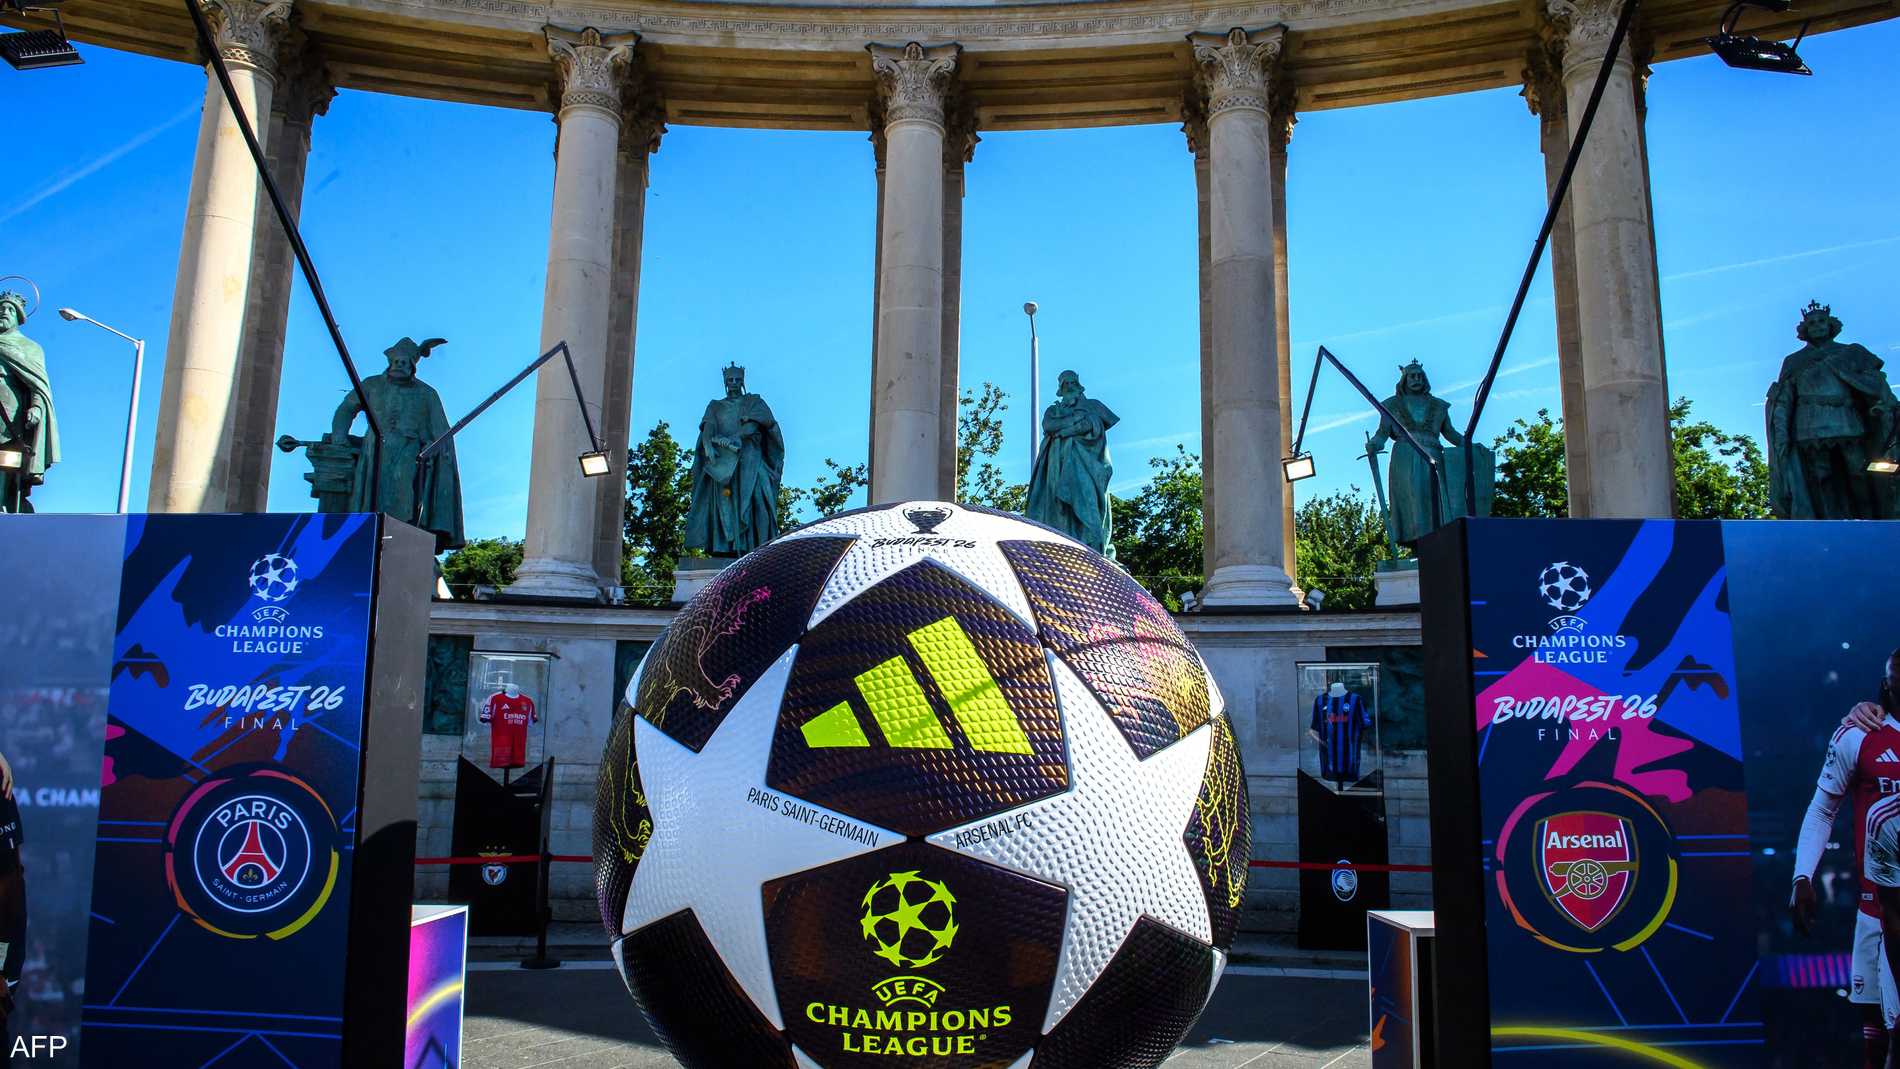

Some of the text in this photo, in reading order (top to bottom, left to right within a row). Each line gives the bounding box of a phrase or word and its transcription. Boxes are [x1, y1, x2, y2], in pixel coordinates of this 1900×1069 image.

[871, 536, 977, 549] BUDAPEST 26
[253, 609, 286, 621] UEFA
[214, 625, 324, 639] CHAMPIONS
[1551, 618, 1584, 631] UEFA
[232, 641, 304, 654] LEAGUE
[1512, 635, 1627, 648] CHAMPIONS
[1534, 651, 1608, 664] LEAGUE
[184, 684, 346, 712] BUDAPEST 26
[1492, 694, 1659, 724] BUDAPEST 26
[225, 716, 299, 731] FINAL
[1538, 728, 1617, 741] FINAL
[216, 801, 292, 828] PARIS
[747, 787, 880, 848] PARIS SAINT-GERMAIN
[956, 812, 1033, 850] ARSENAL FC
[1547, 830, 1623, 849] Arsenal
[875, 981, 939, 1004] UEFA
[806, 1002, 1013, 1031] CHAMPIONS
[842, 1032, 976, 1056] LEAGUE
